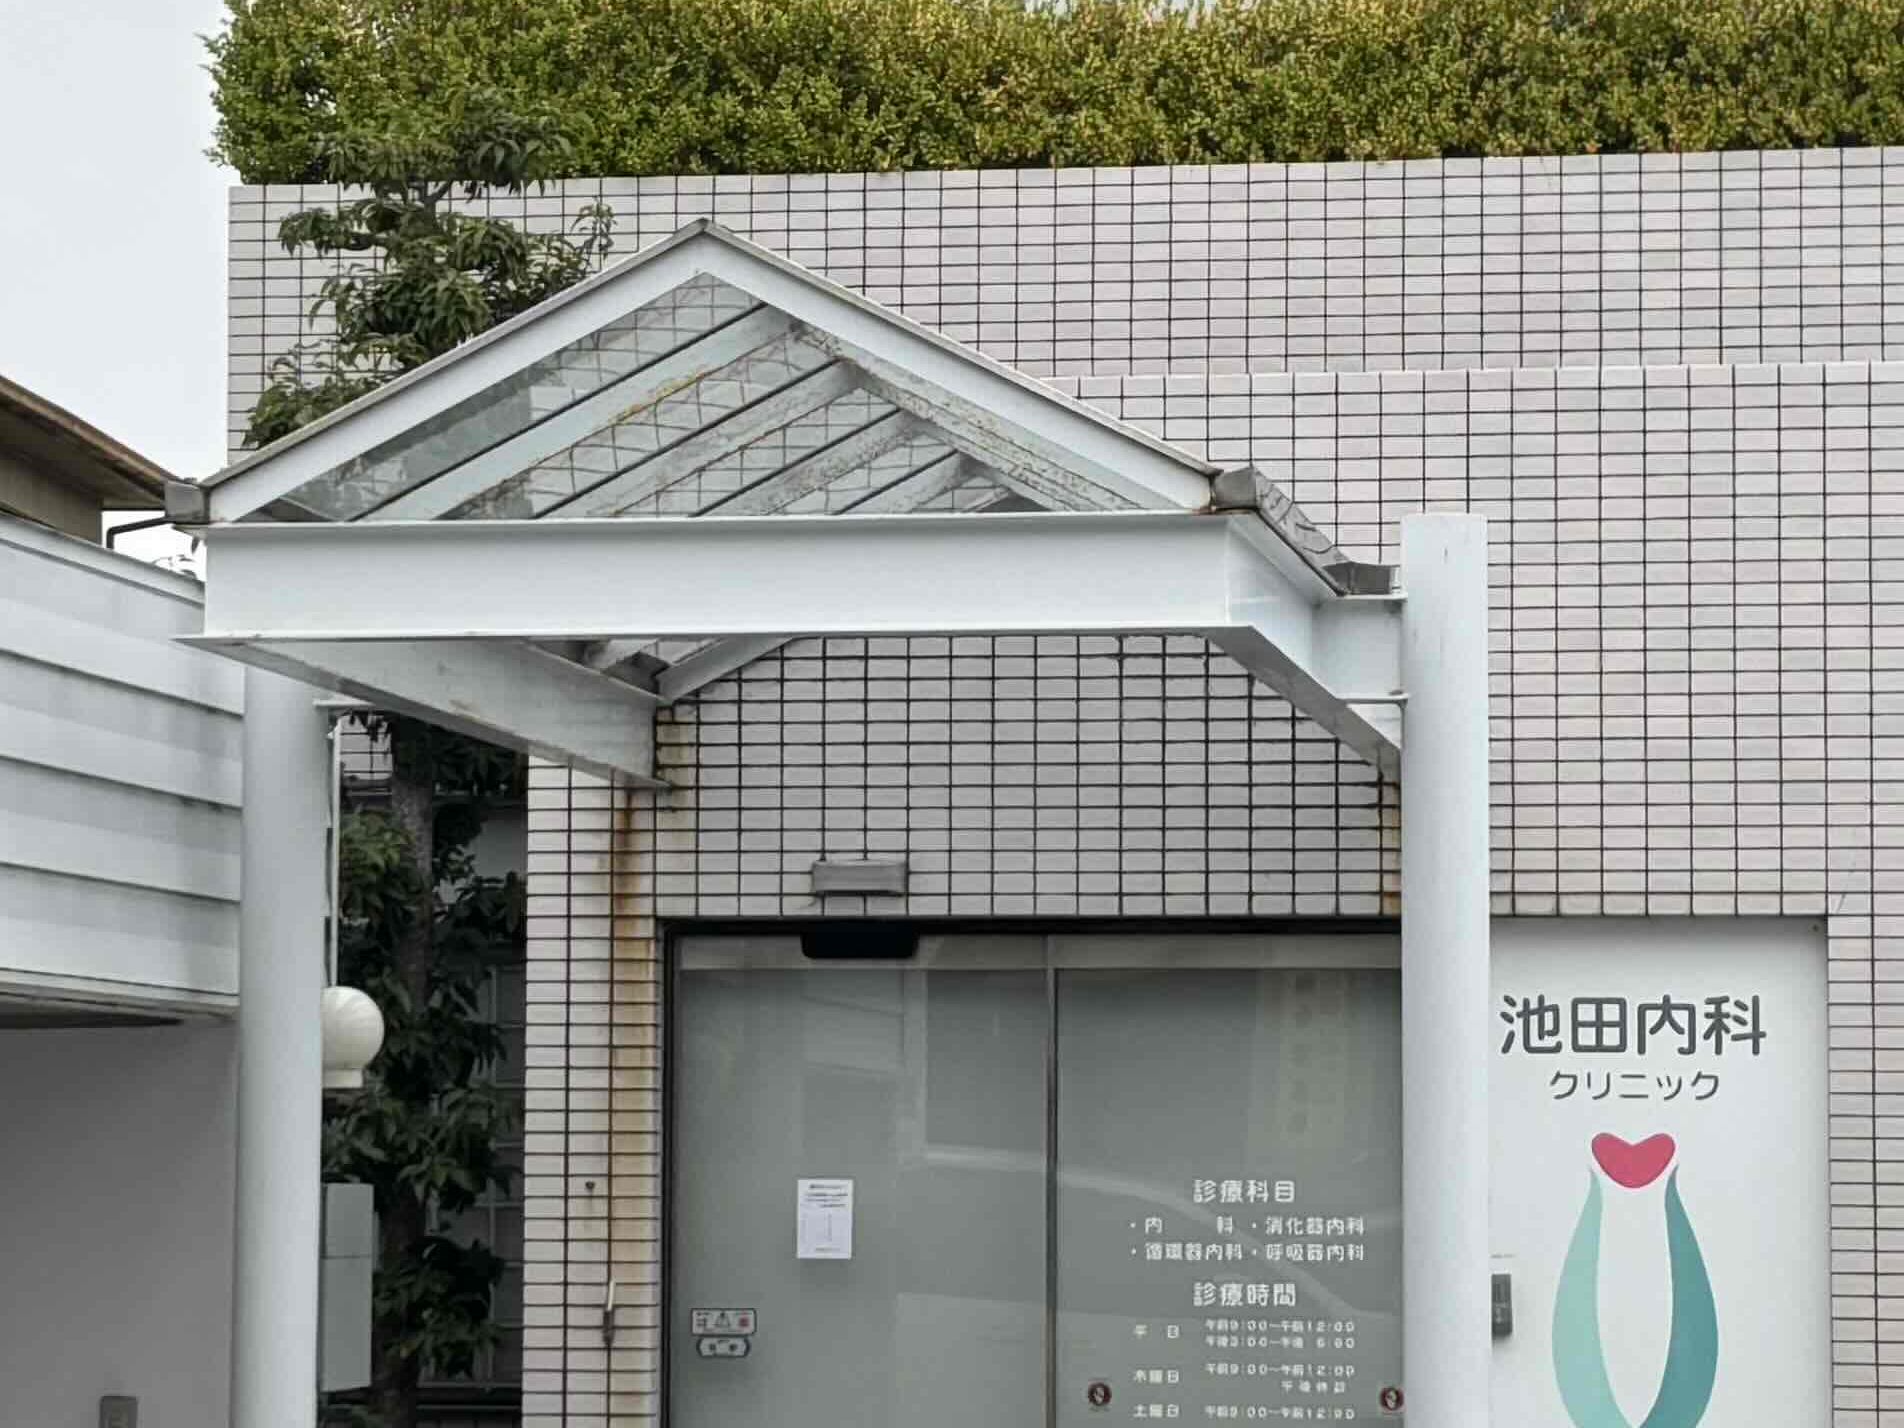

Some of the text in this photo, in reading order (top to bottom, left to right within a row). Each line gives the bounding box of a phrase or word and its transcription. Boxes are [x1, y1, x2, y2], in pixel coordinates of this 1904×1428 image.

[1499, 994, 1767, 1056] 池田内科
[1550, 1071, 1721, 1101] クリニック
[1193, 1180, 1295, 1203] 診療科目
[1193, 1283, 1296, 1307] 診療時間
[1133, 1404, 1180, 1418] 土曜日
